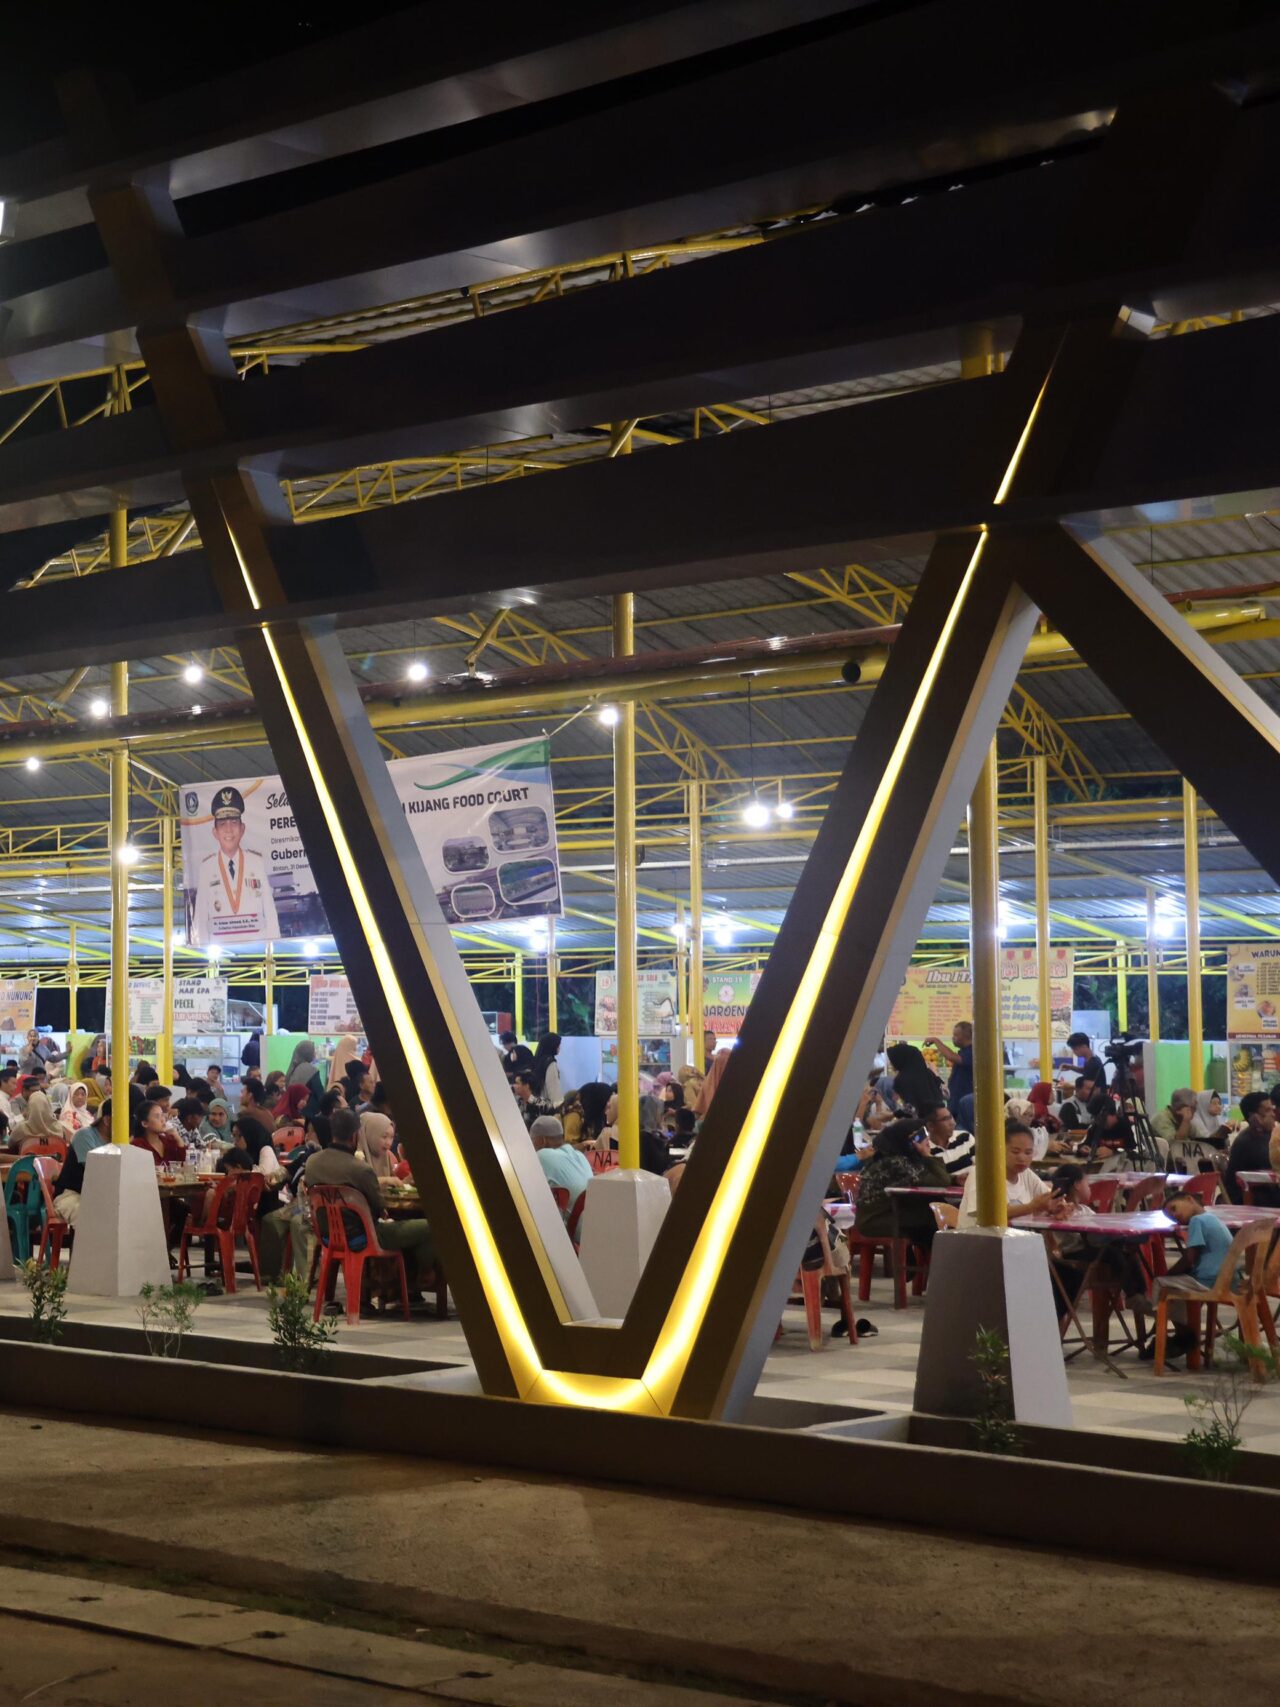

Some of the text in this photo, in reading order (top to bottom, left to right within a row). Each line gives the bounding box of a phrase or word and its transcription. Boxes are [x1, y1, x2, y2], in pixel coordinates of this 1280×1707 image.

[408, 787, 529, 814] KIJANG FOOD COURT
[1182, 1142, 1205, 1159] NA
[594, 1151, 612, 1168] NA
